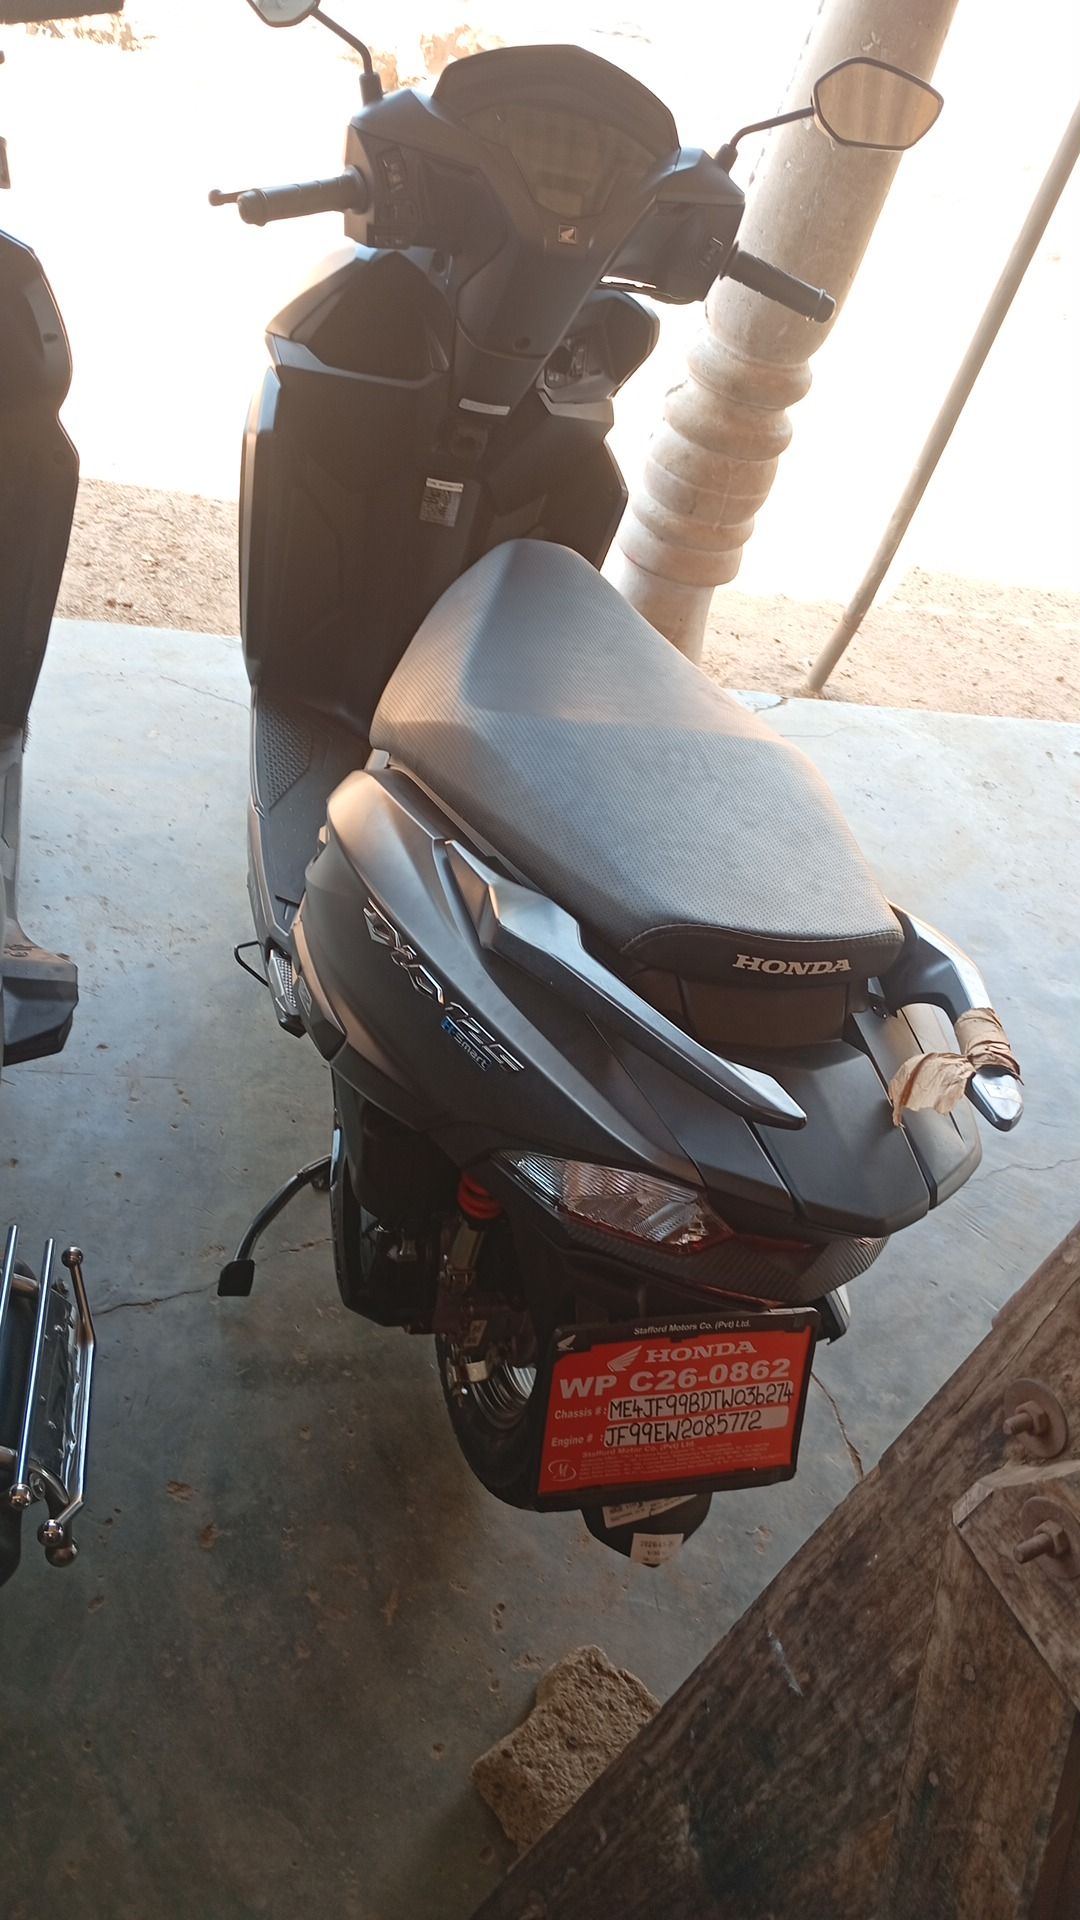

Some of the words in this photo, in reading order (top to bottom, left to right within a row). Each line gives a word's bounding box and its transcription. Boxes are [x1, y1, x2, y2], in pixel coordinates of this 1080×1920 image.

[732, 954, 852, 975] HONDA
[633, 1325, 668, 1336] Stafford
[668, 1323, 698, 1332] Motors
[699, 1321, 713, 1330] Co.
[715, 1320, 735, 1330] (Pvt)
[644, 1341, 757, 1363] HONDA
[559, 1375, 617, 1399] WP
[629, 1358, 791, 1393] C26-0862
[554, 1408, 593, 1420] Chassis
[605, 1410, 762, 1447] JF99EW2085772
[551, 1435, 585, 1448] Engine
